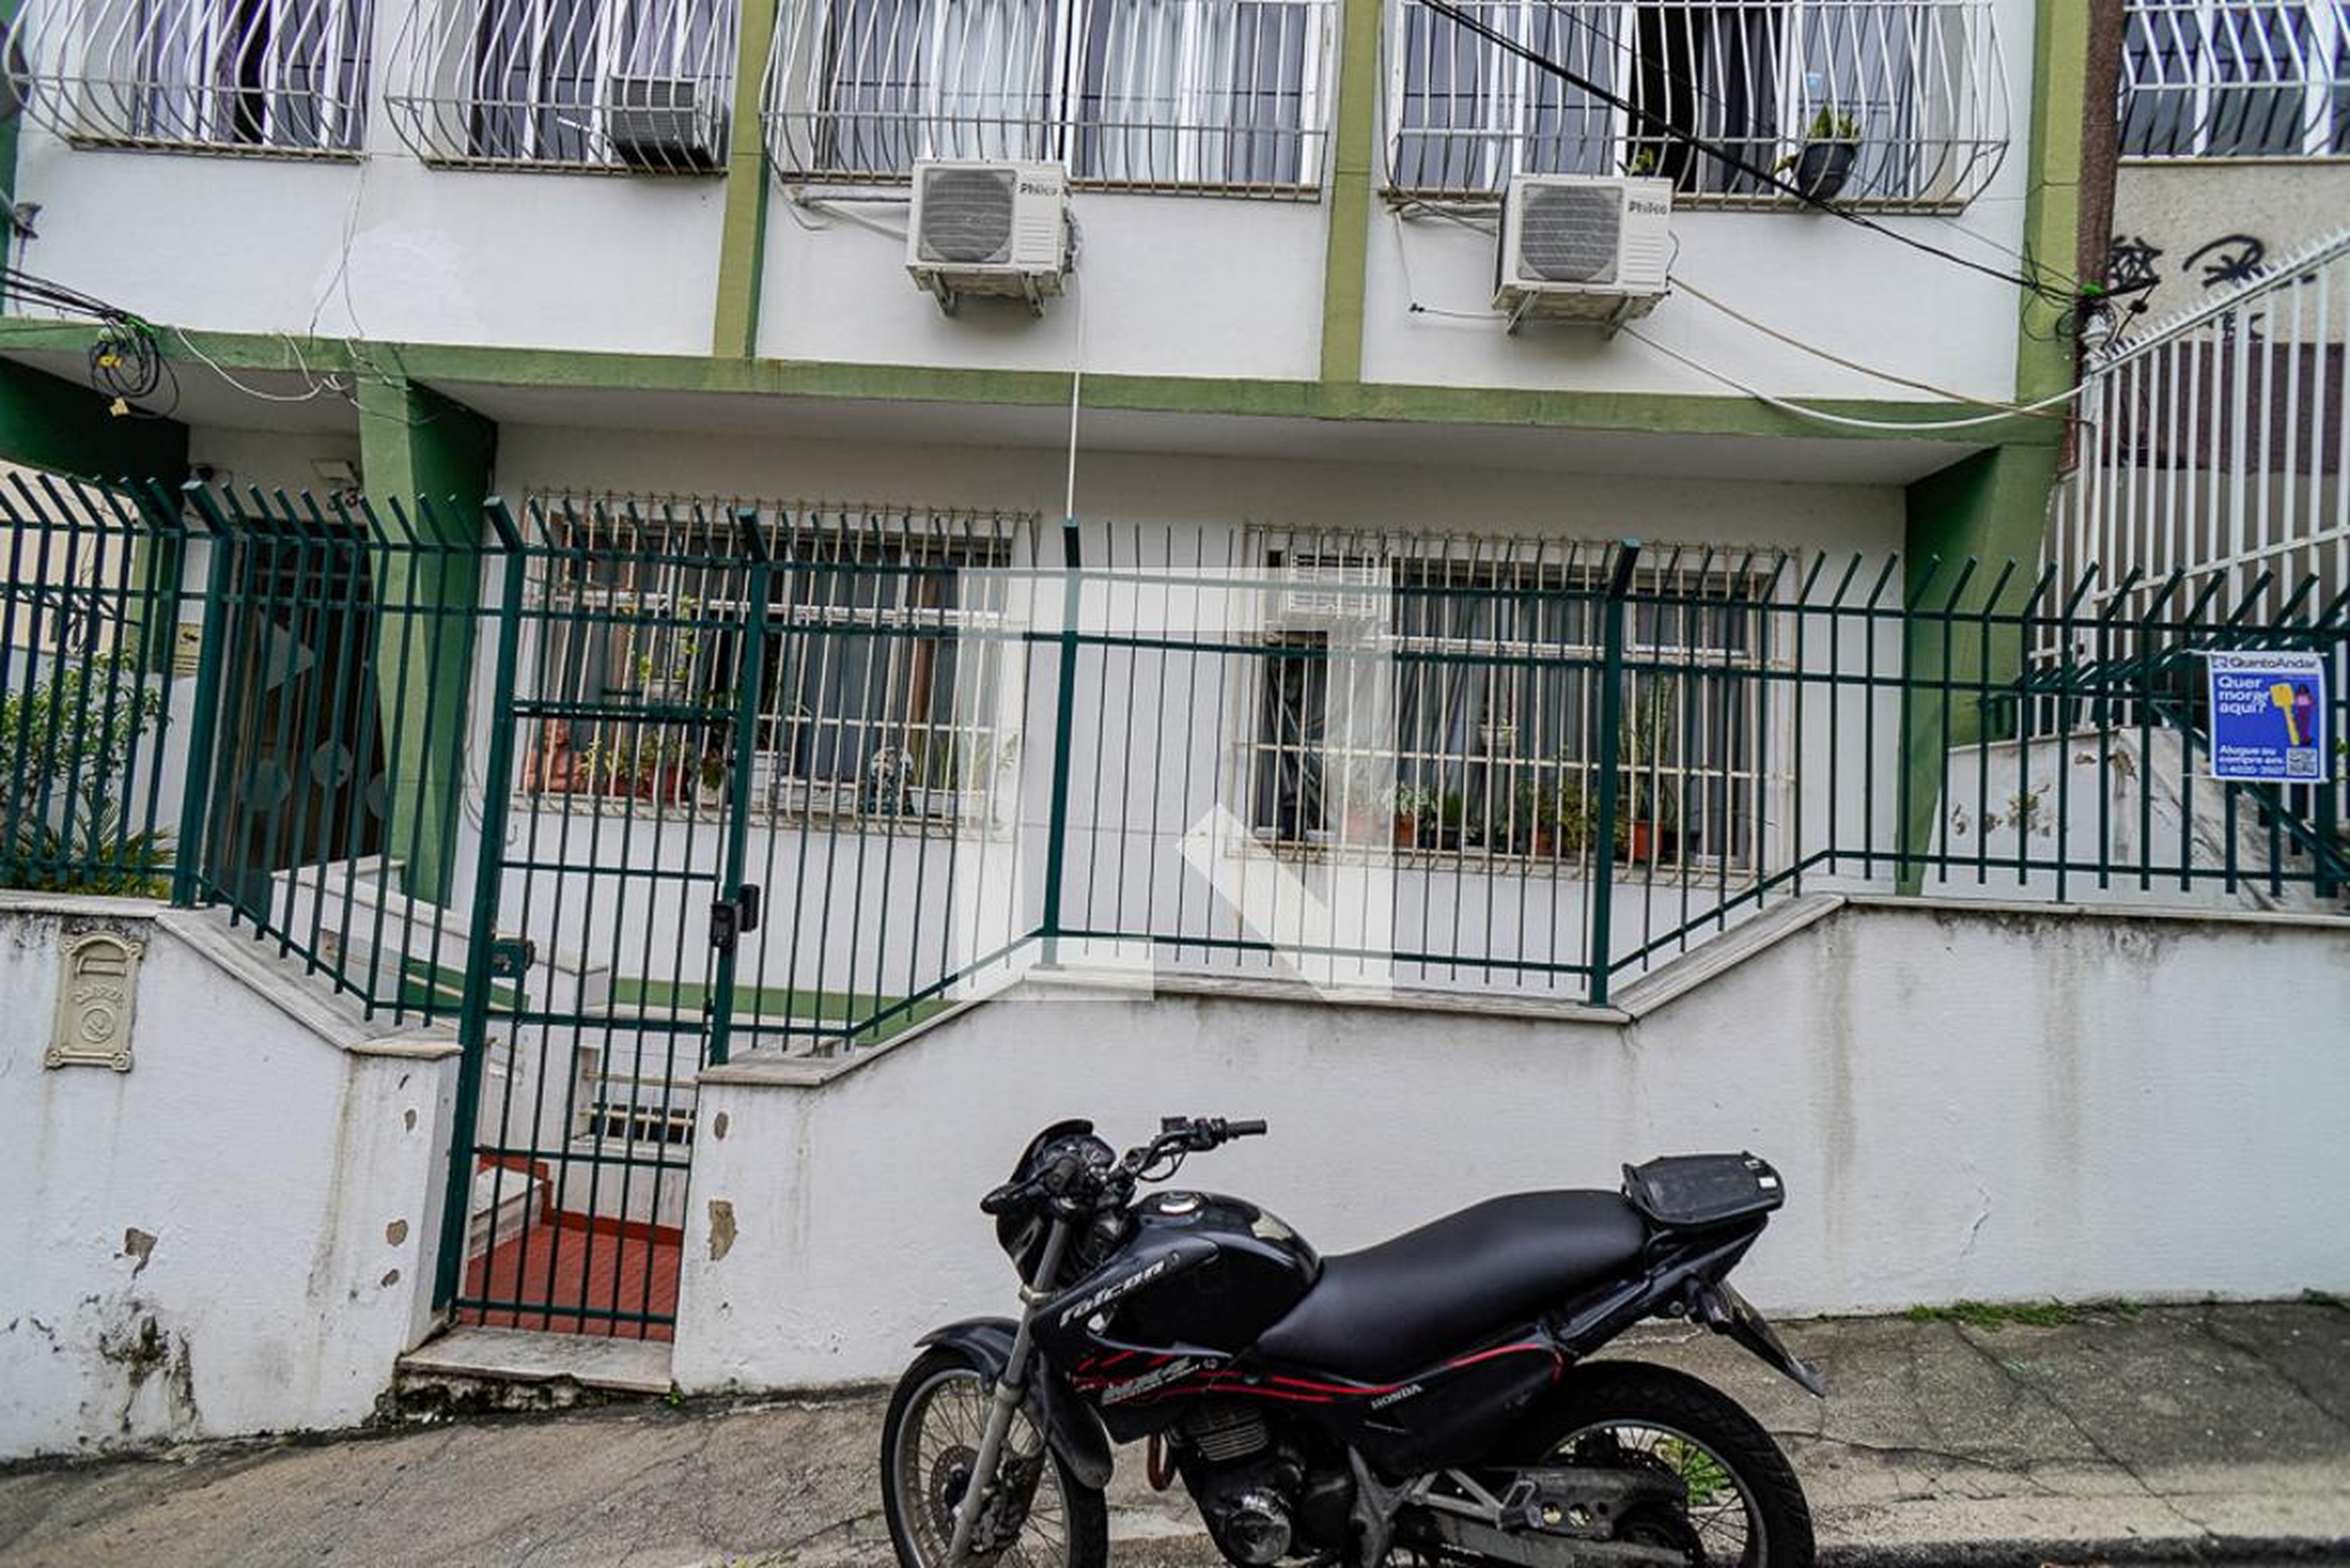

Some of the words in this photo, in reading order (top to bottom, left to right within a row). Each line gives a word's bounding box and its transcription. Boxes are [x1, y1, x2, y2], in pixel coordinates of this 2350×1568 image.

[1019, 183, 1058, 196] Philco
[1628, 200, 1668, 215] Philco
[2229, 655, 2316, 668] QuintoAndar
[2218, 675, 2262, 689] Quer
[2219, 701, 2266, 715] aqui?
[1370, 1383, 1423, 1411] HONDA
